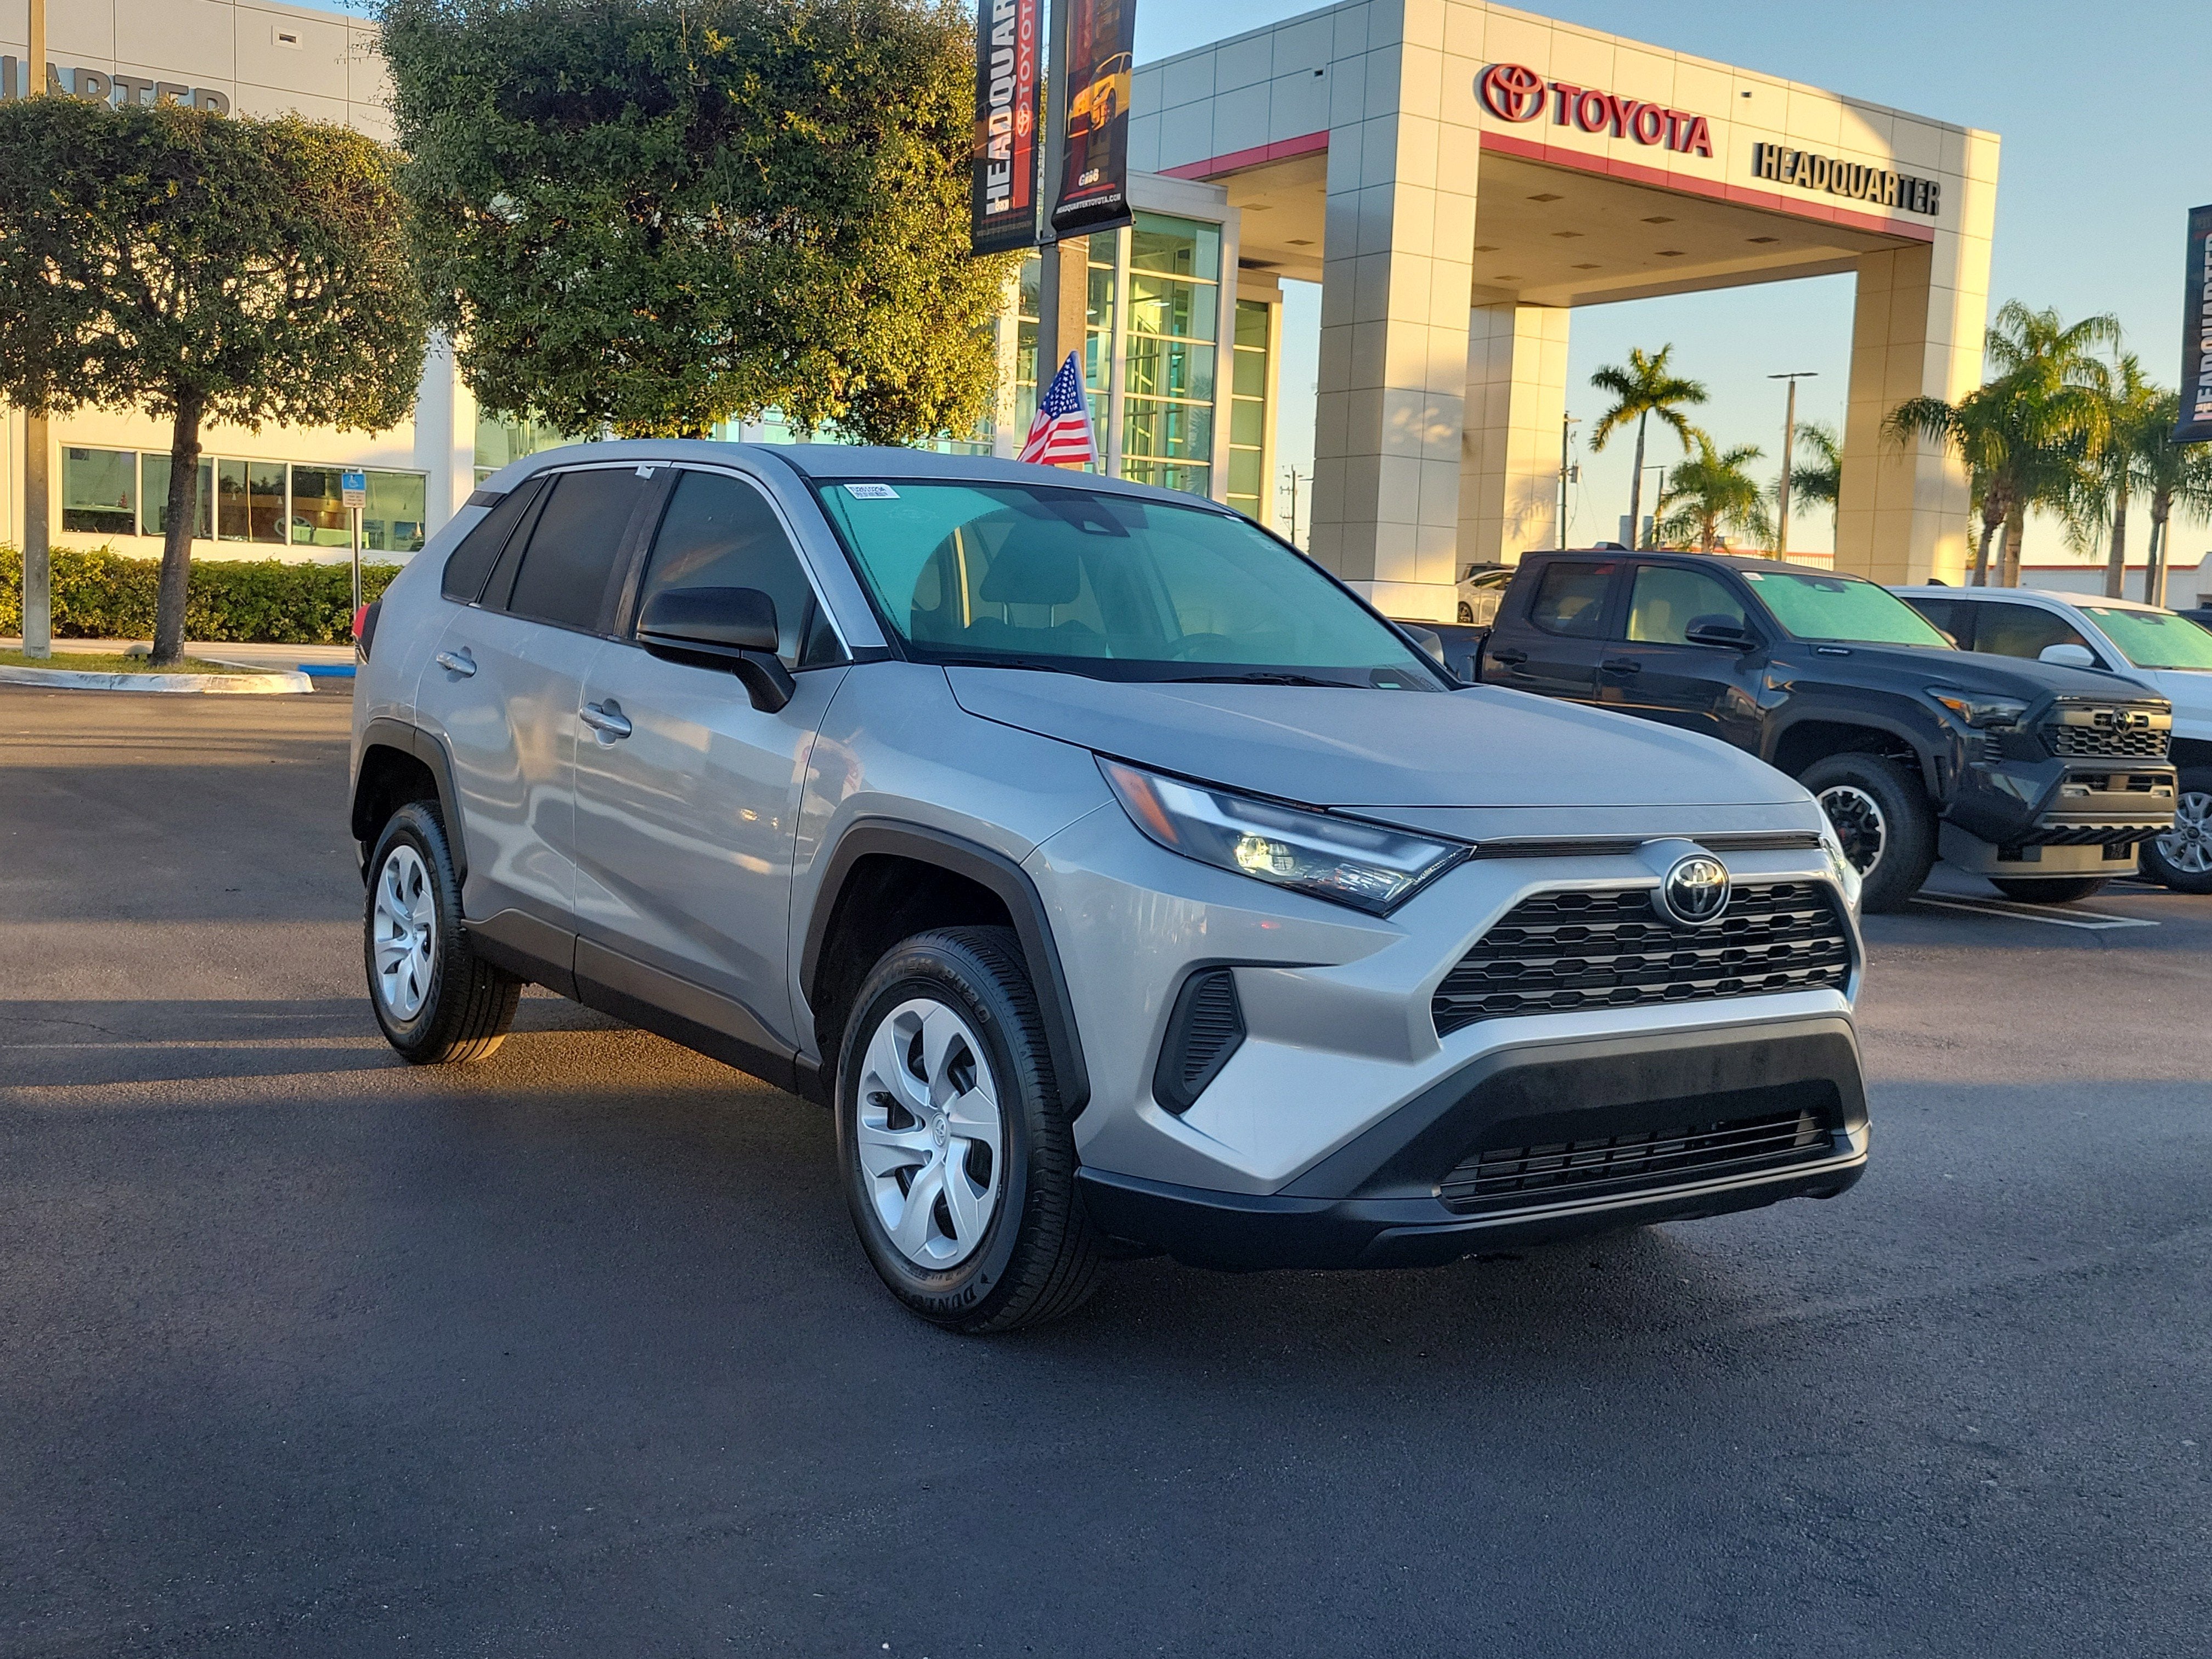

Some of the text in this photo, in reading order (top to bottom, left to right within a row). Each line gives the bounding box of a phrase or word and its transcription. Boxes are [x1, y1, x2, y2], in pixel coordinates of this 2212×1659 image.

[1019, 0, 1033, 100] TOYOT
[1554, 82, 1713, 158] TOYOTA
[1759, 143, 1941, 216] HEADQUARTER
